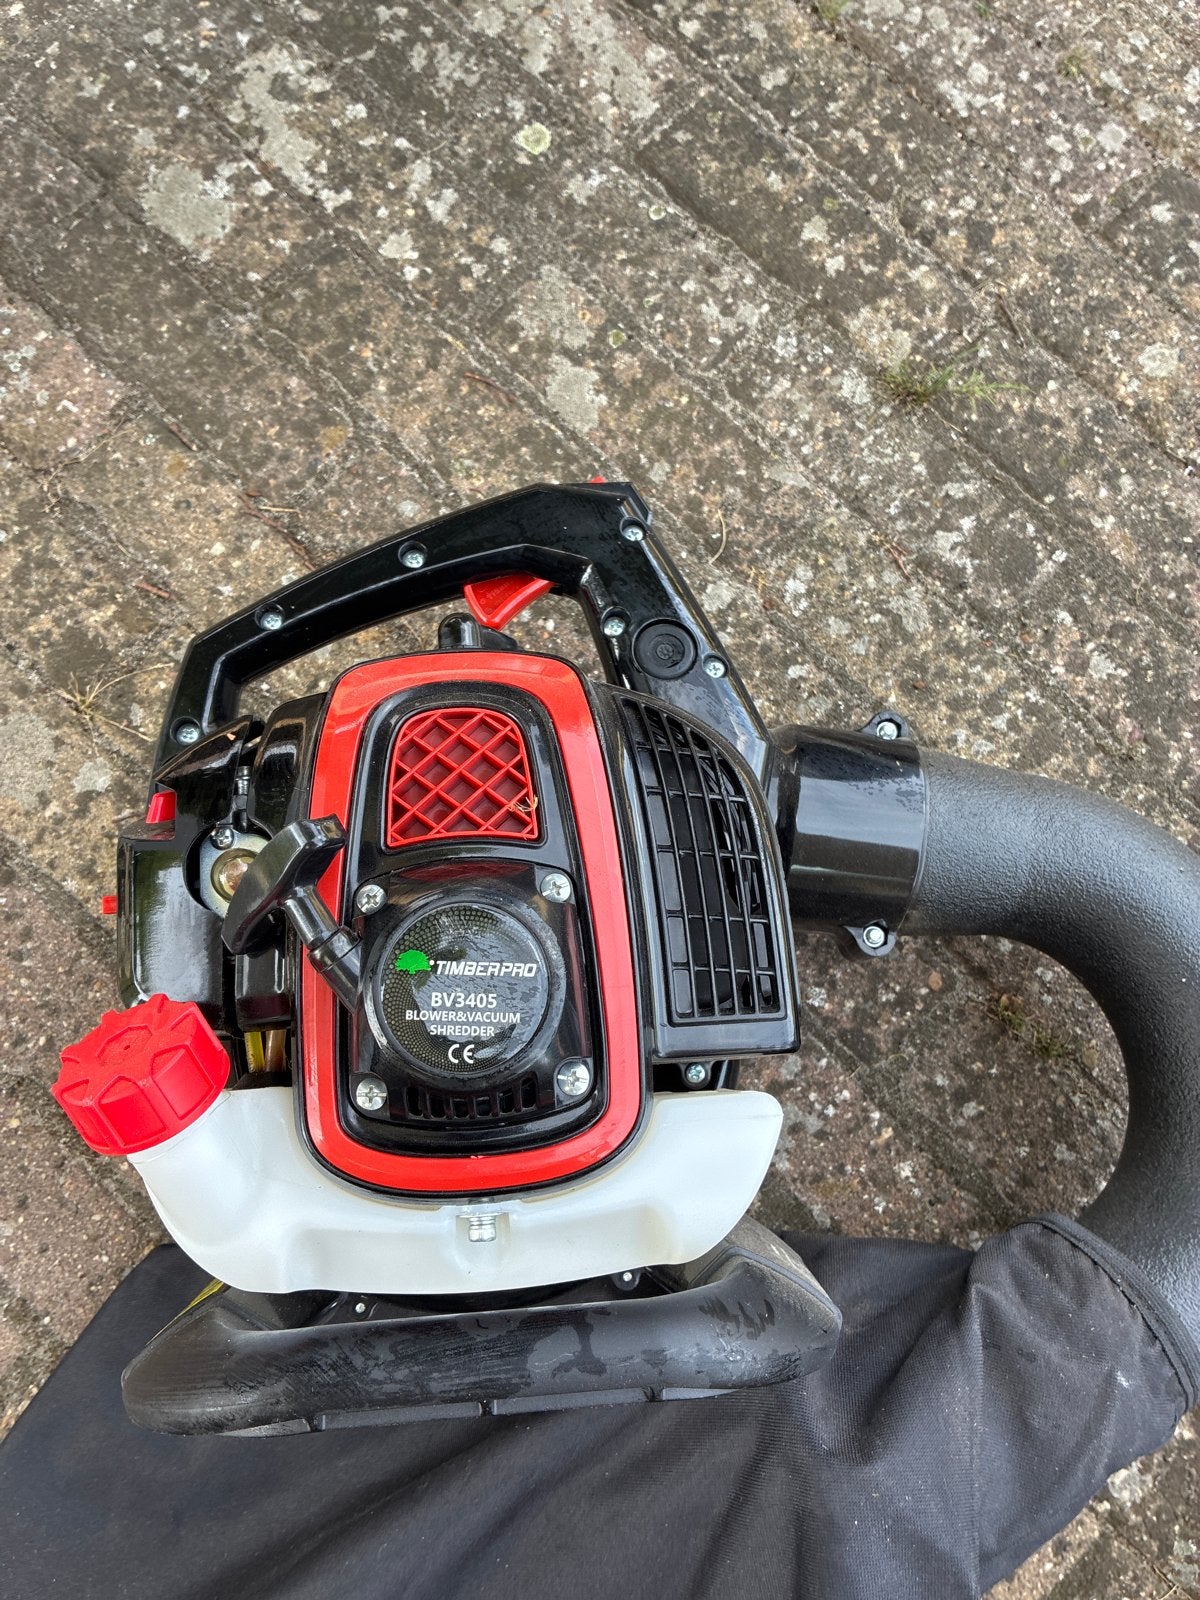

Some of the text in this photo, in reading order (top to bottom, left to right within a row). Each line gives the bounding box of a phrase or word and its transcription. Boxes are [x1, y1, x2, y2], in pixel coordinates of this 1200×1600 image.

[436, 960, 537, 977] TIMBERPRO
[431, 992, 497, 1008] BV3405
[405, 1010, 521, 1023] BLOWER&VACUUM
[430, 1024, 495, 1037] SHREDDER
